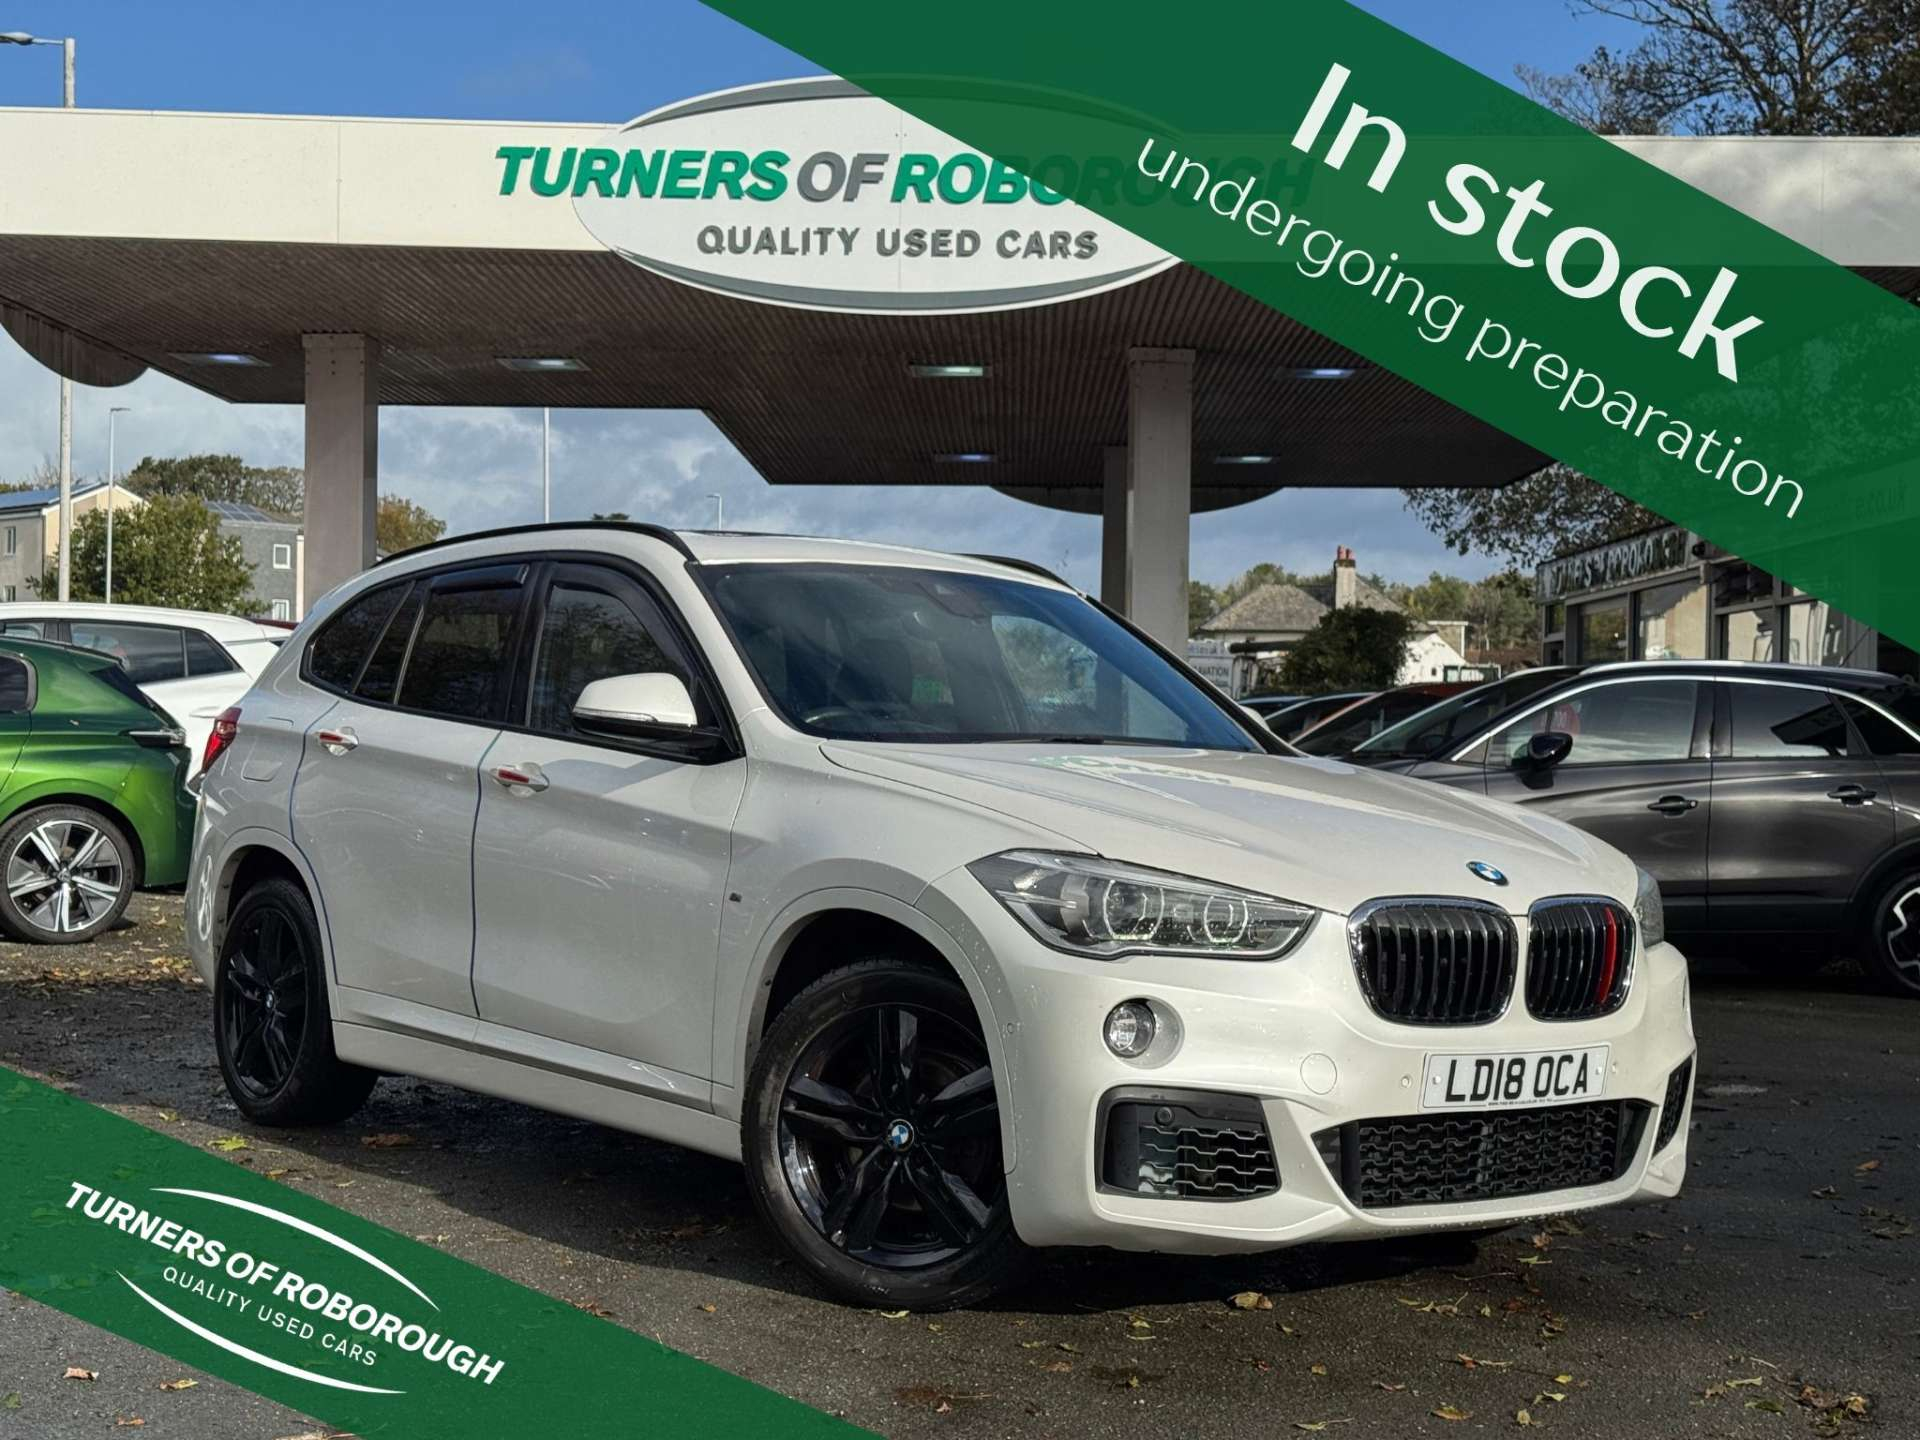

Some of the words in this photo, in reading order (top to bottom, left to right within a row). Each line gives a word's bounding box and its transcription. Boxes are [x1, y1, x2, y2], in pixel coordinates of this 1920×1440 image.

[495, 145, 792, 204] TURNERS
[796, 151, 890, 203] OF
[697, 225, 860, 256] QUALITY
[876, 228, 981, 258] USED
[996, 229, 1099, 260] CARS
[1445, 1058, 1526, 1103] LD18
[1533, 1053, 1588, 1098] OCA
